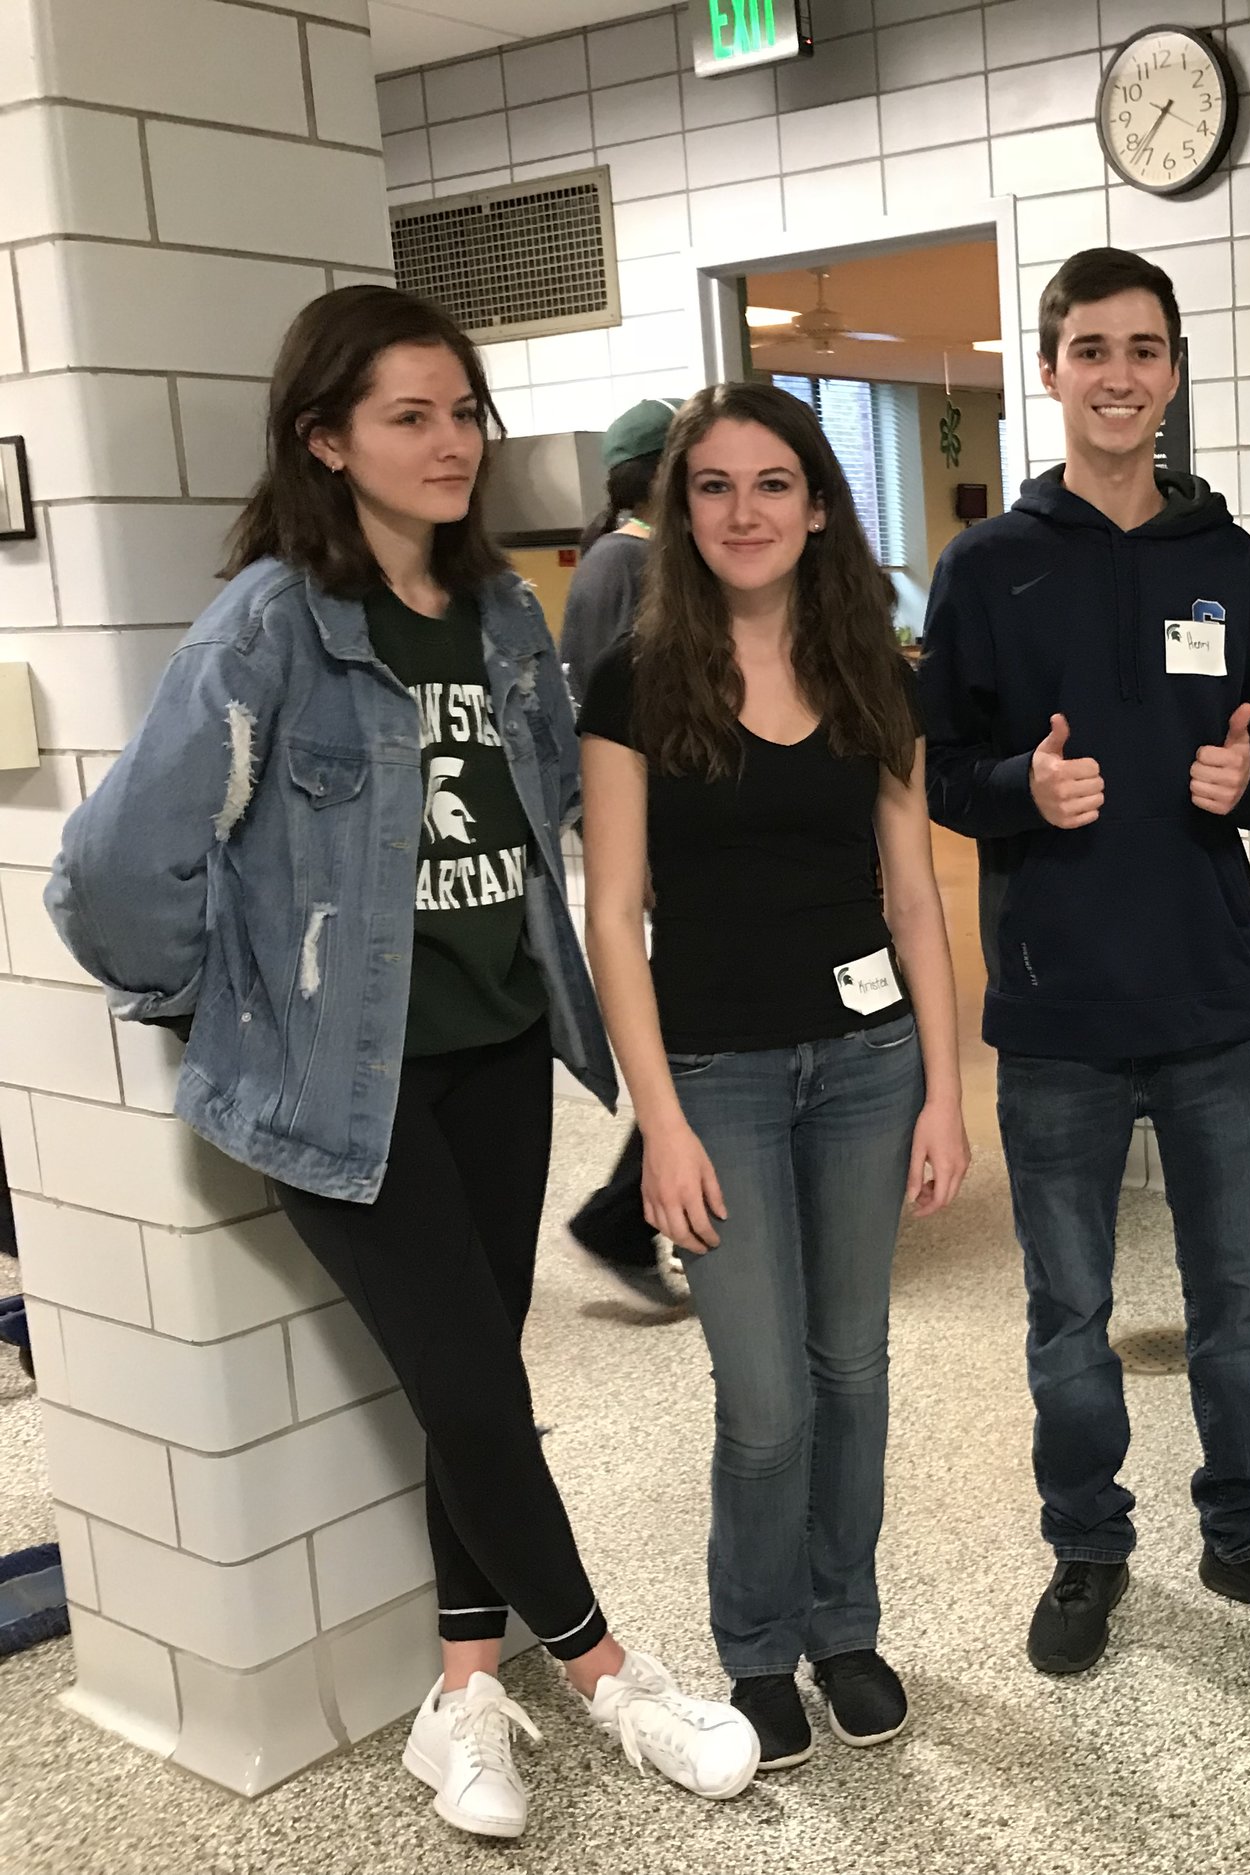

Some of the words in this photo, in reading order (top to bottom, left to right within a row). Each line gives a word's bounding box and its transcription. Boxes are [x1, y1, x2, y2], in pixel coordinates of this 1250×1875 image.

[1152, 49, 1172, 70] 12
[1181, 52, 1187, 70] 1
[1136, 62, 1149, 81] 11
[1191, 69, 1204, 88] 2
[1122, 83, 1143, 103] 10
[1199, 93, 1212, 112] 3
[1118, 111, 1132, 128] 9
[1196, 119, 1209, 136] 4
[1126, 133, 1139, 151] 8
[1182, 139, 1195, 159] 5
[1143, 147, 1154, 166] 7
[1163, 152, 1176, 170] 6
[415, 844, 527, 910] ARTAN
